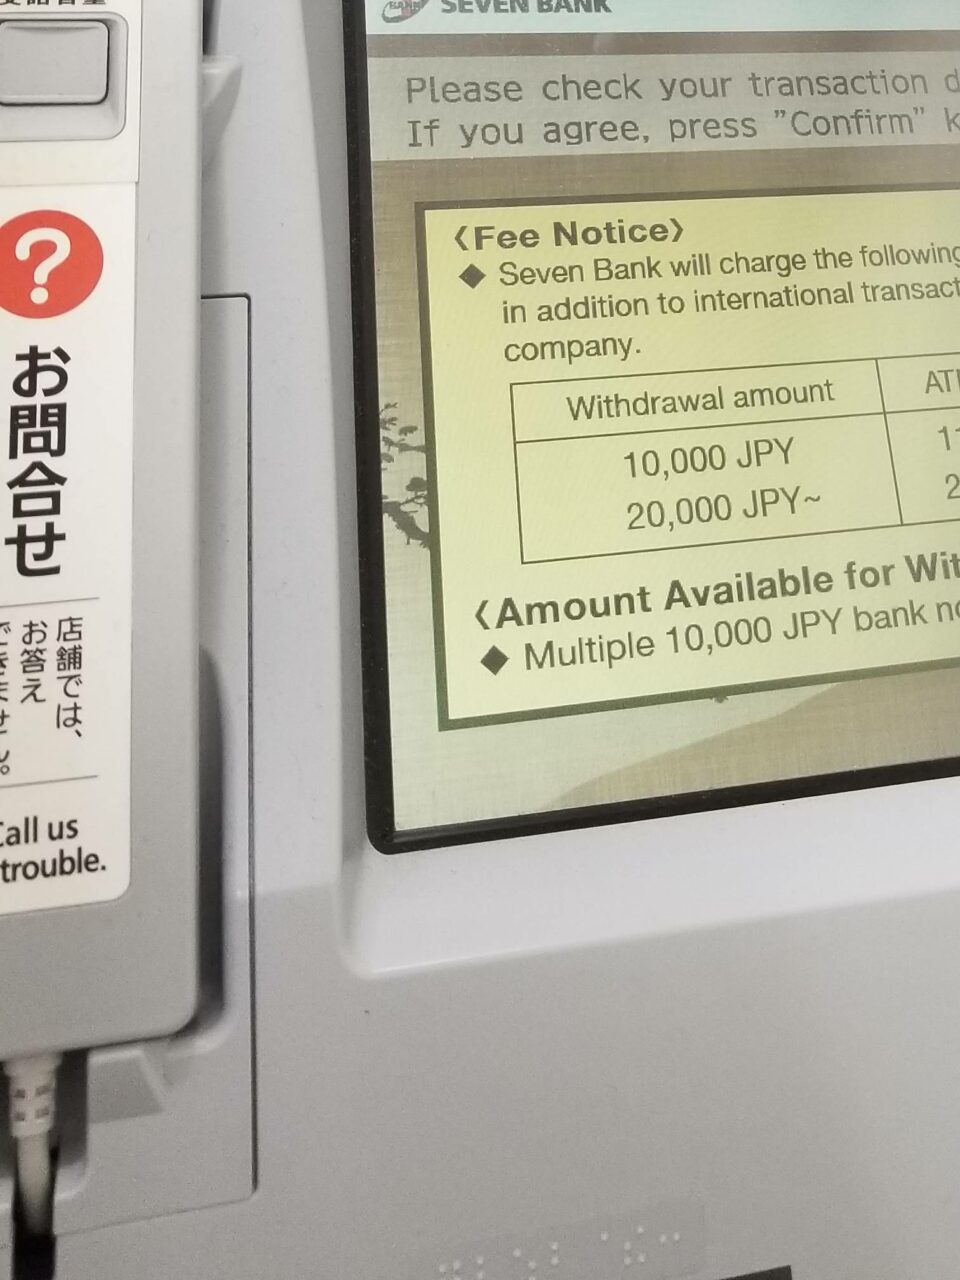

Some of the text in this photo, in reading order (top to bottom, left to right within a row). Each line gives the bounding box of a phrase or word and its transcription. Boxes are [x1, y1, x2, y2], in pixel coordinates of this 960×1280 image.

[406, 75, 523, 104] Please
[542, 73, 641, 101] check
[658, 75, 732, 101] your
[748, 69, 928, 97] transaction
[408, 118, 440, 148] If
[459, 121, 524, 148] you
[543, 119, 651, 146] agree,
[669, 113, 758, 143] press
[499, 261, 584, 286] Seven
[593, 254, 663, 282] Bank
[669, 253, 711, 278] will
[719, 249, 807, 278] charge
[812, 247, 853, 270] the
[502, 299, 527, 324] in
[537, 293, 649, 322] addition
[658, 291, 685, 315] to
[693, 281, 854, 313] international
[503, 335, 642, 365] company.
[567, 379, 835, 422] Withdrawal amount
[5, 344, 71, 578] お問合せ
[623, 436, 795, 481] 10,000 JPY
[627, 494, 732, 532] 20,000
[664, 565, 834, 611] Available
[844, 560, 896, 591] for
[524, 631, 655, 671] Multiple
[666, 615, 771, 657] 10,000
[783, 607, 844, 640] JPY
[854, 600, 928, 632] bank
[20, 620, 48, 705] お答え
[56, 616, 84, 738] 店舗では、
[48, 818, 78, 841] us
[1, 847, 106, 883] trouble.
